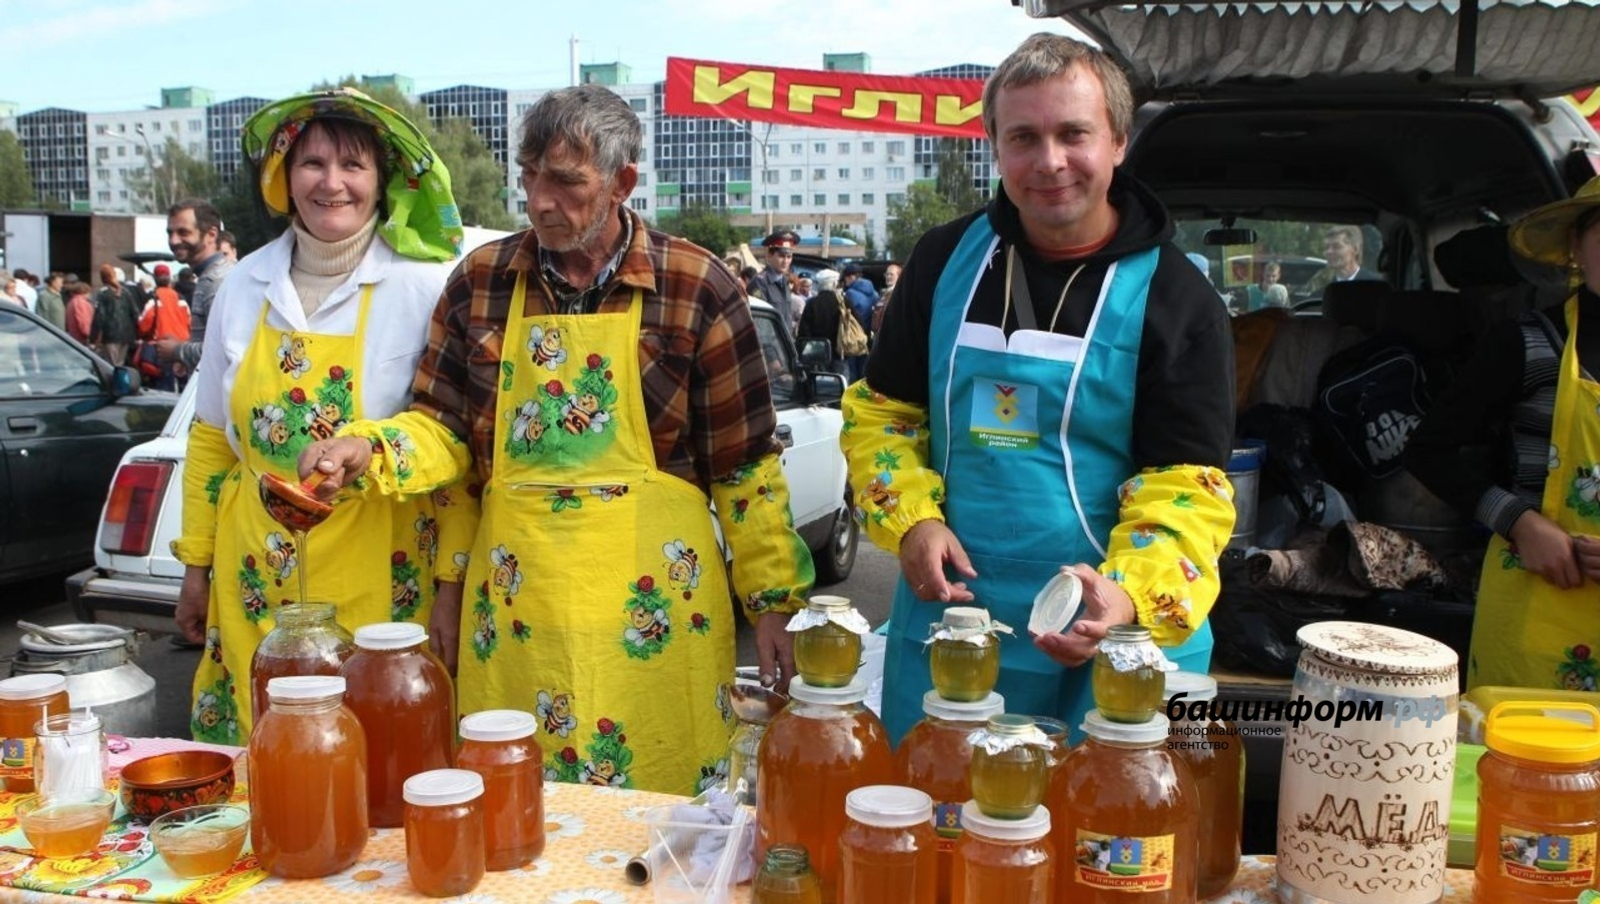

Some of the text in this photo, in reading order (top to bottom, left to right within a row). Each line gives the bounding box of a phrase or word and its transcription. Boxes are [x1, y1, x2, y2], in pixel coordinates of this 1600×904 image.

[978, 432, 1029, 444] Иглинский
[988, 440, 1017, 449] район
[1312, 793, 1448, 845] МЁД
